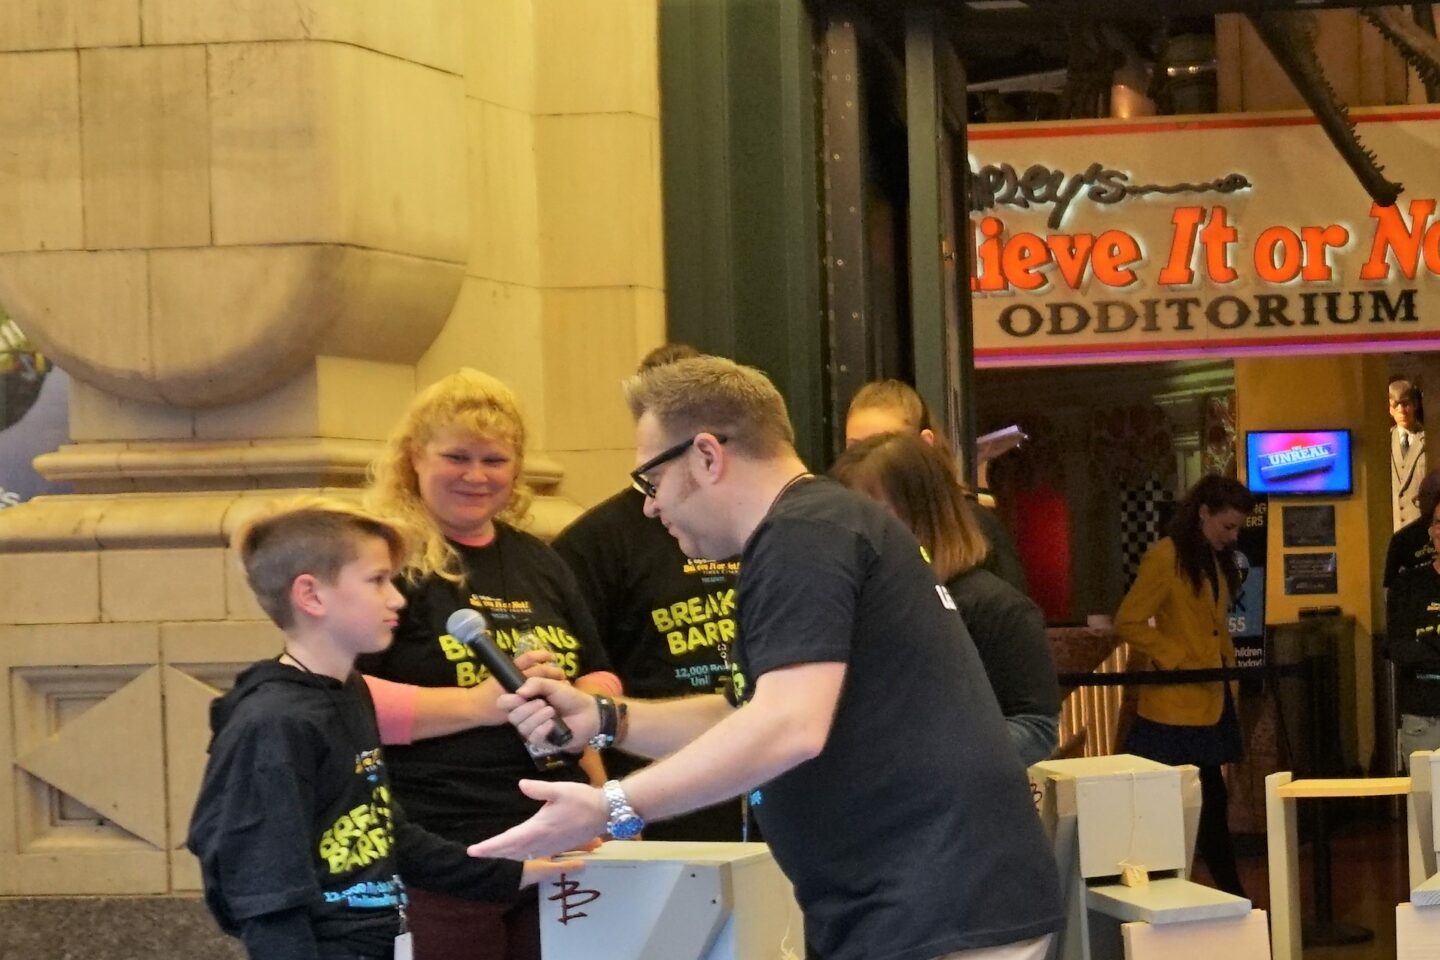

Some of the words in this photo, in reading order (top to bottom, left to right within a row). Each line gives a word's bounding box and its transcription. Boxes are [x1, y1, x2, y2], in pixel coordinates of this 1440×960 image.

[970, 217, 1143, 292] ieve
[1159, 205, 1238, 285] It
[1253, 223, 1349, 283] or
[998, 289, 1419, 337] ODDITORIUM
[1267, 446, 1329, 466] UNREAL
[652, 588, 735, 632] BREAK
[667, 618, 735, 655] BARR
[1235, 647, 1262, 657] hildren
[675, 665, 708, 679] 12,000
